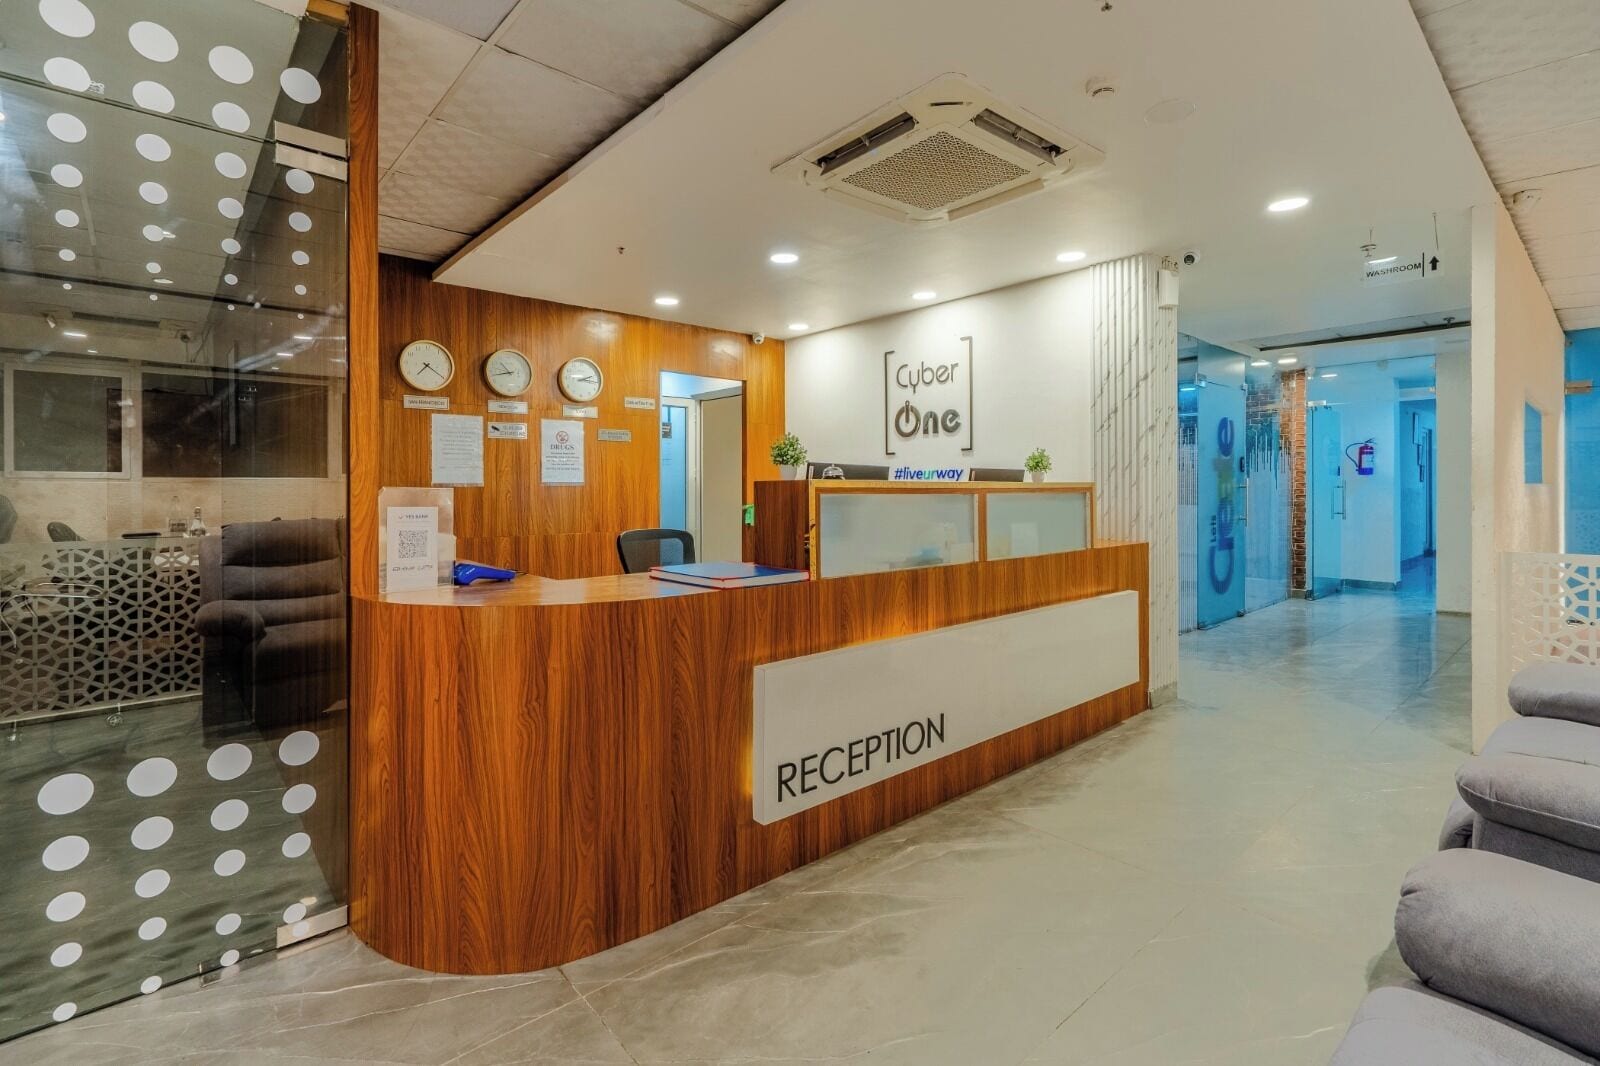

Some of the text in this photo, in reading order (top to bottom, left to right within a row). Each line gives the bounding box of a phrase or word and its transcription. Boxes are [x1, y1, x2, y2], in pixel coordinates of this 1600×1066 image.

[1366, 263, 1421, 277] WASHROOM
[896, 361, 958, 393] Cyber
[894, 400, 961, 437] One
[894, 466, 963, 481] #liveurway
[777, 713, 945, 802] RECEPTION
